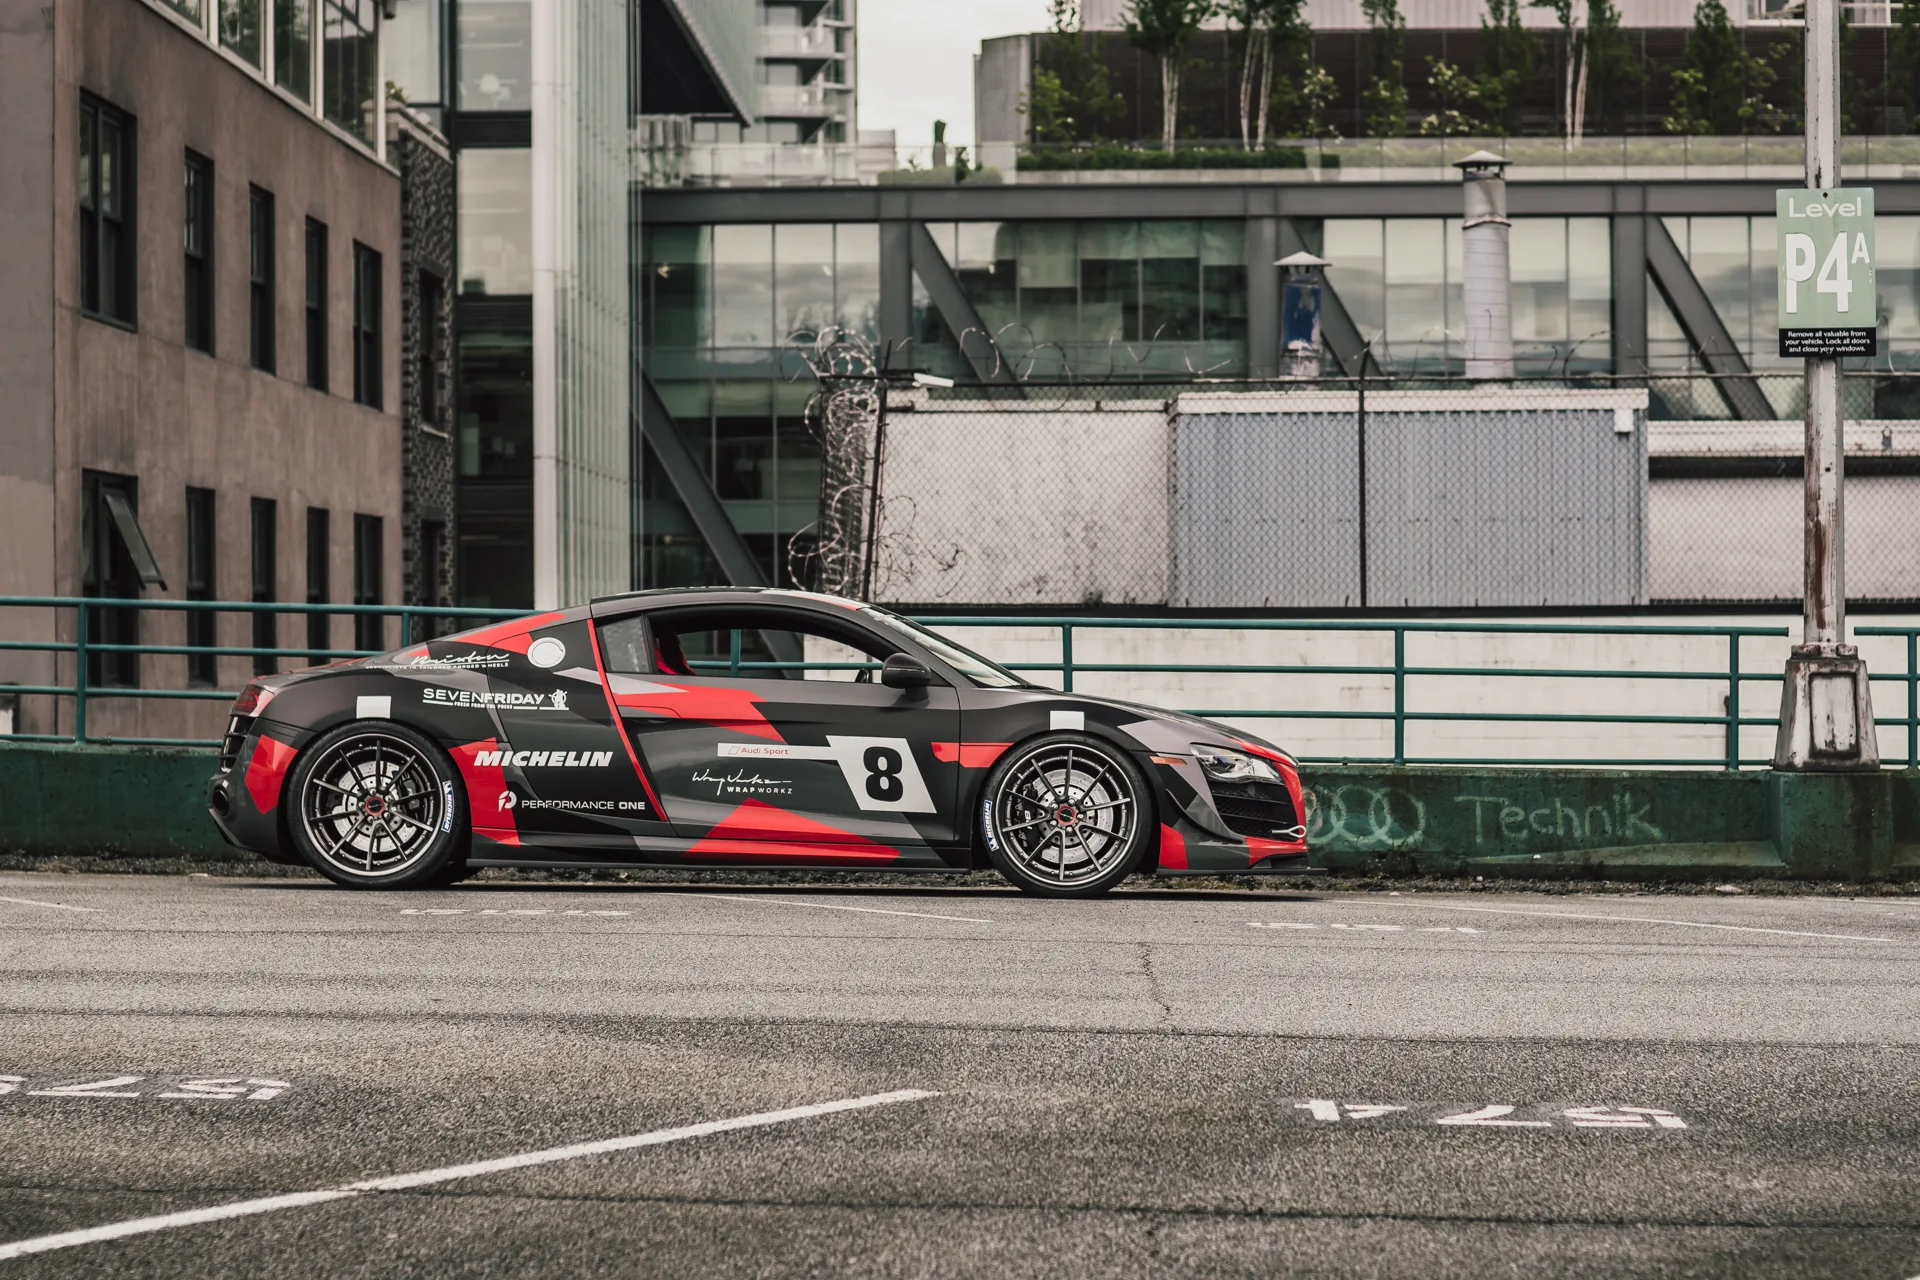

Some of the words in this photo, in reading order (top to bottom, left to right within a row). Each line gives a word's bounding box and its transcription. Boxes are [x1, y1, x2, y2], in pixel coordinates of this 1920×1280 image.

[1788, 197, 1861, 217] Level
[423, 688, 544, 704] SEVENFRIDAY
[474, 750, 613, 767] MICHELIN
[863, 746, 903, 802] 8
[444, 794, 453, 829] MICHELIN
[522, 800, 614, 810] PERFORMANCE
[619, 802, 646, 810] ONE
[1455, 792, 1662, 844] Technik
[0, 1075, 291, 1101] 57
[1294, 1099, 1689, 1129] 574
